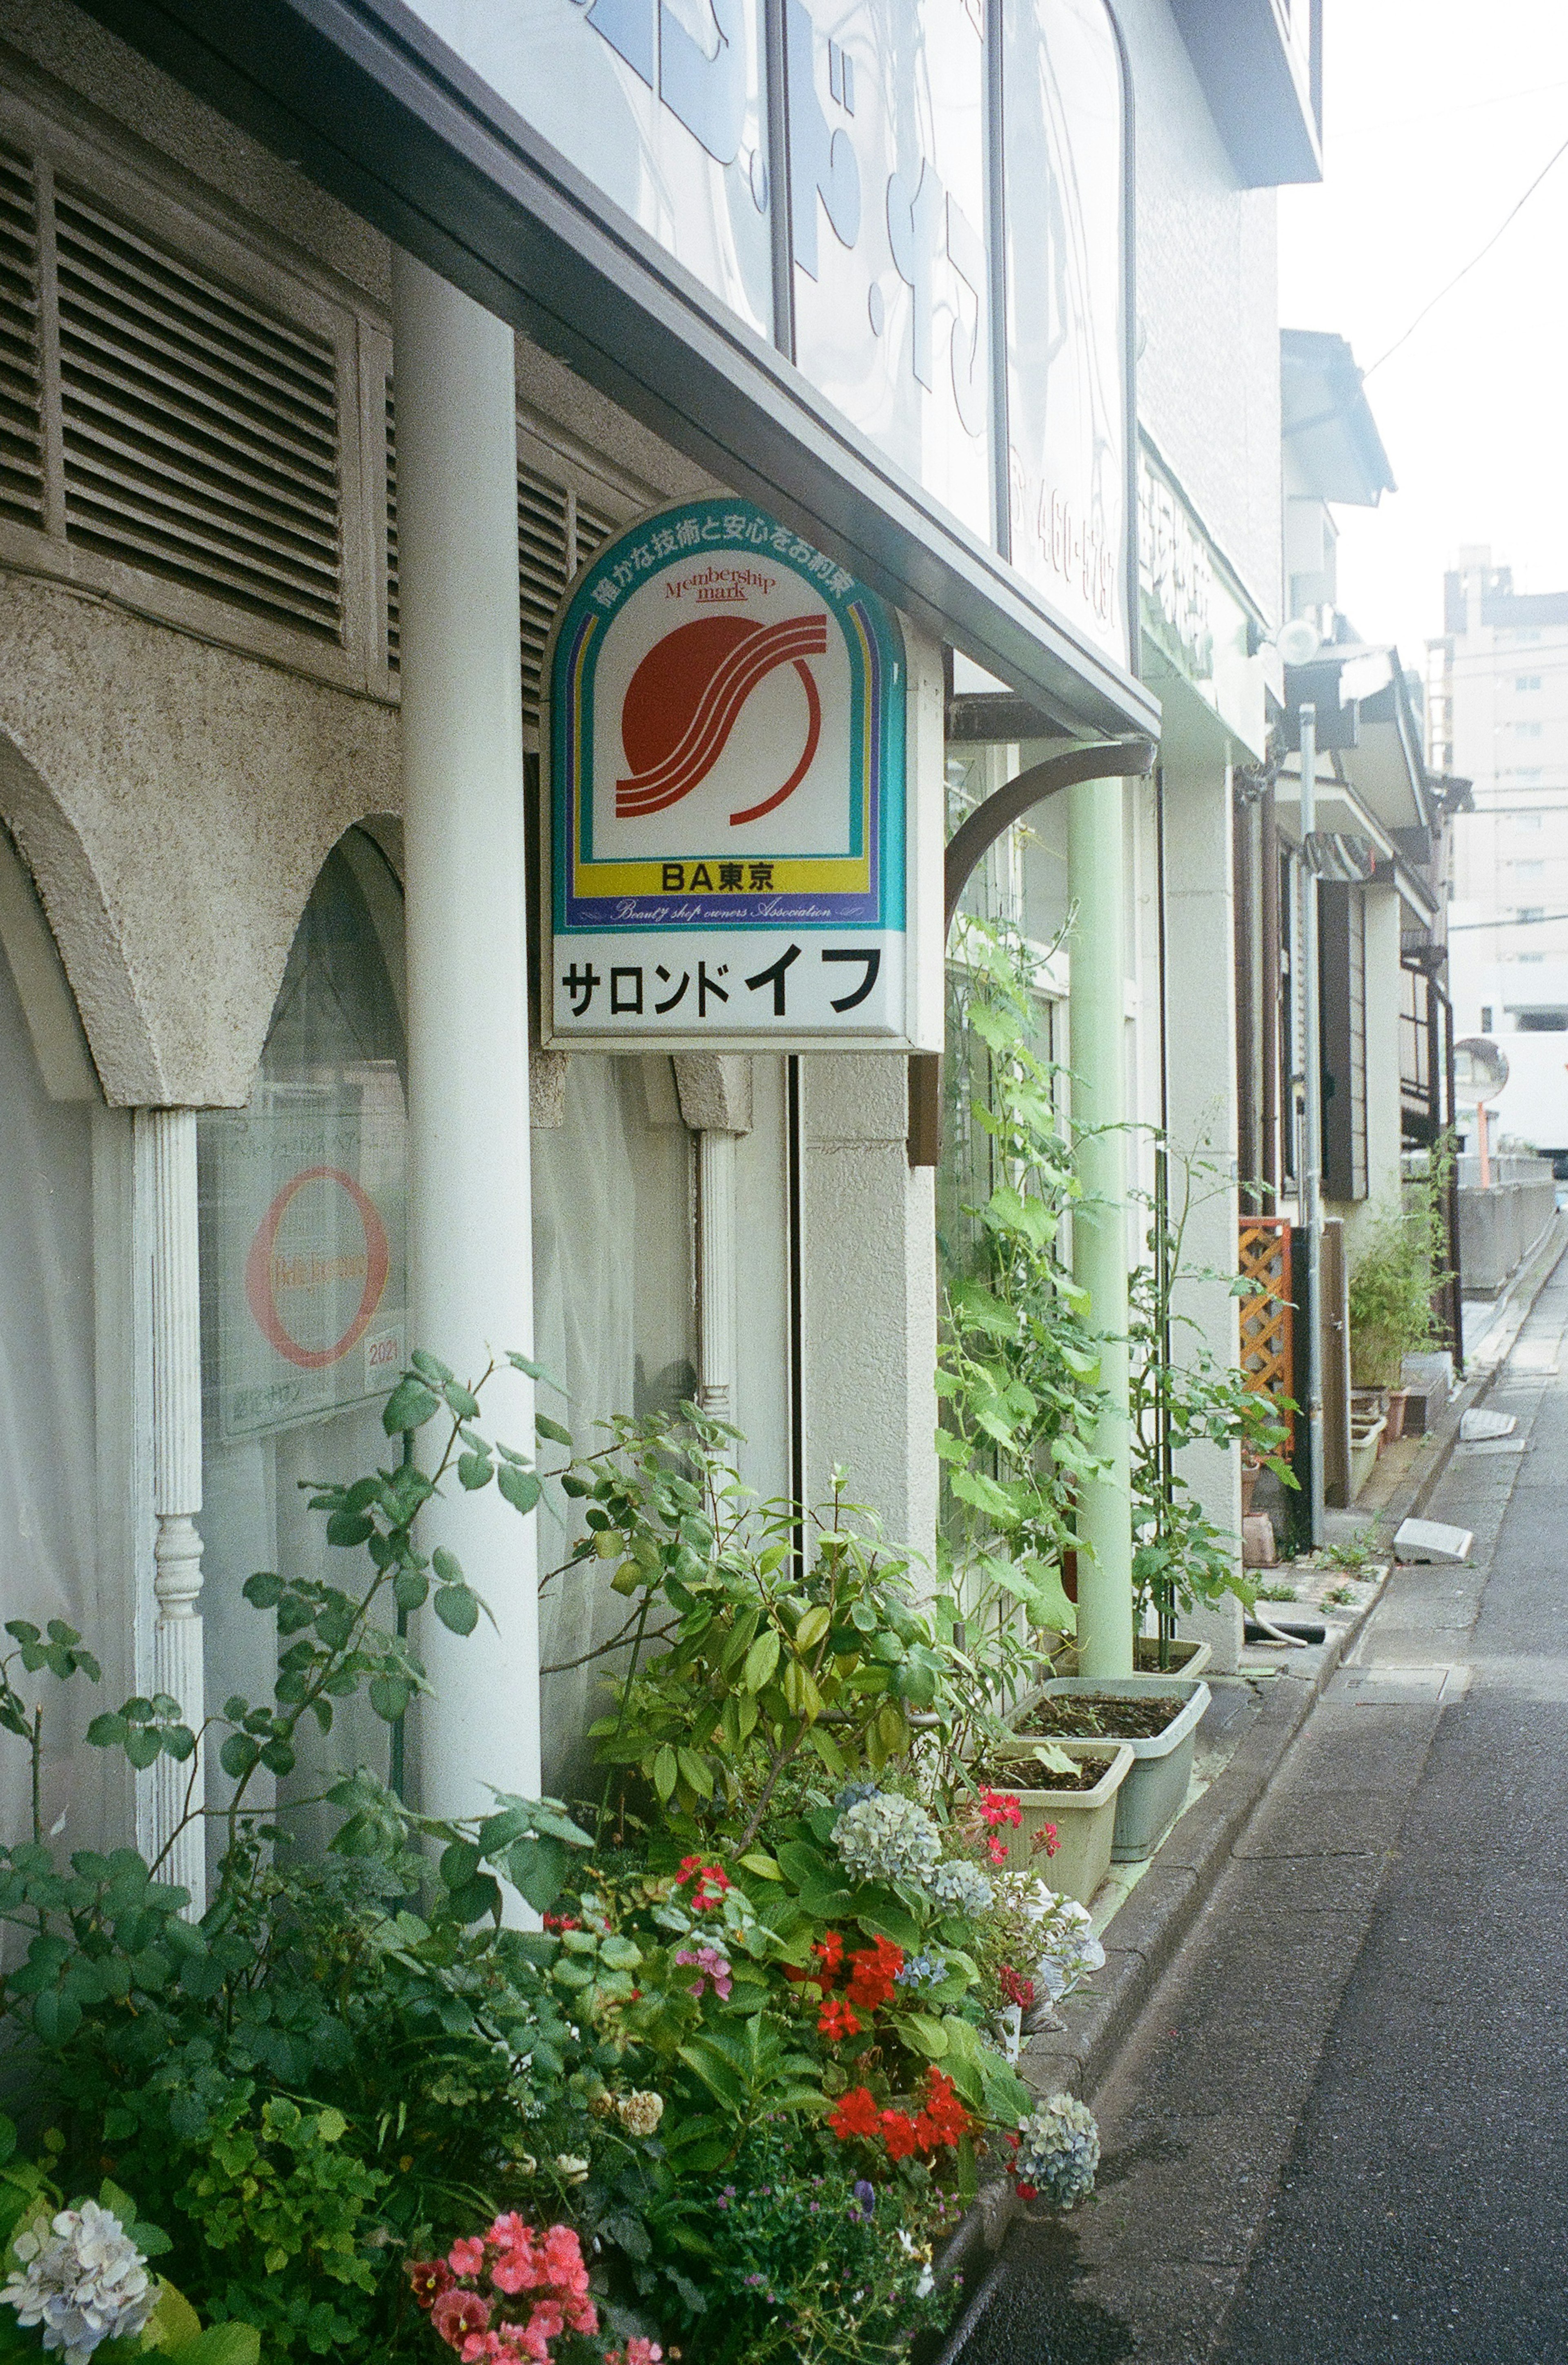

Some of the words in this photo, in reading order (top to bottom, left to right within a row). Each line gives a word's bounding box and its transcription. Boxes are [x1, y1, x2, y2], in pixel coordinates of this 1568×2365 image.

[665, 566, 776, 594] Membership
[697, 582, 746, 599] mark
[662, 863, 774, 892] BA東京
[610, 898, 669, 922] Beauty
[671, 903, 702, 921] shop
[704, 909, 748, 918] owners
[750, 896, 831, 917] Association
[562, 944, 881, 1017] サロンドイフ
